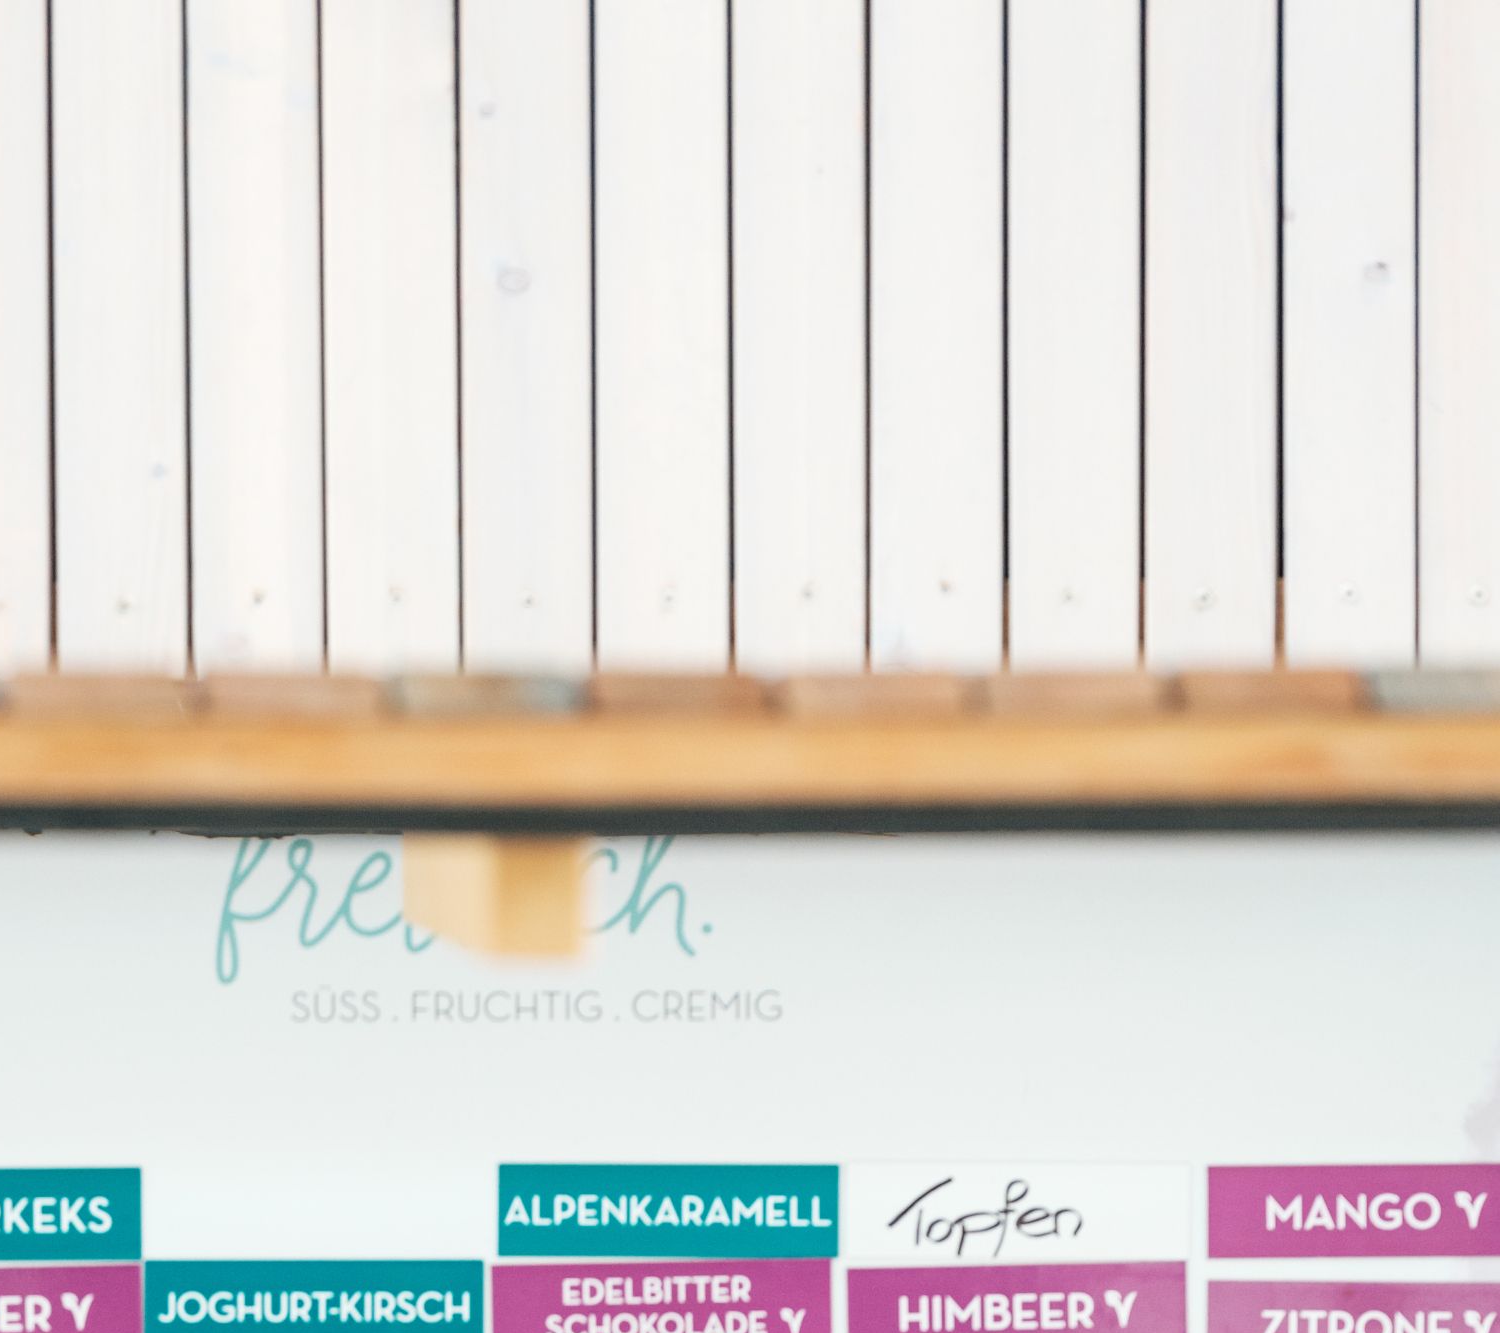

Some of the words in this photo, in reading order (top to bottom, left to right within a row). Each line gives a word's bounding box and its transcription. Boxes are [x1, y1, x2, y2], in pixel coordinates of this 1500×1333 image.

[291, 985, 381, 1023] SÜSS
[411, 989, 603, 1023] FRUCHTIG
[631, 989, 783, 1022] CREMIG
[504, 1194, 832, 1227] ALPENKARAMELL
[888, 1178, 1082, 1256] Topfen
[1266, 1192, 1441, 1231] MANGO
[157, 1291, 470, 1323] JOGHURT-KIRSCH
[562, 1275, 751, 1306] EDELBITTER
[899, 1292, 1095, 1332] HIMBEER
